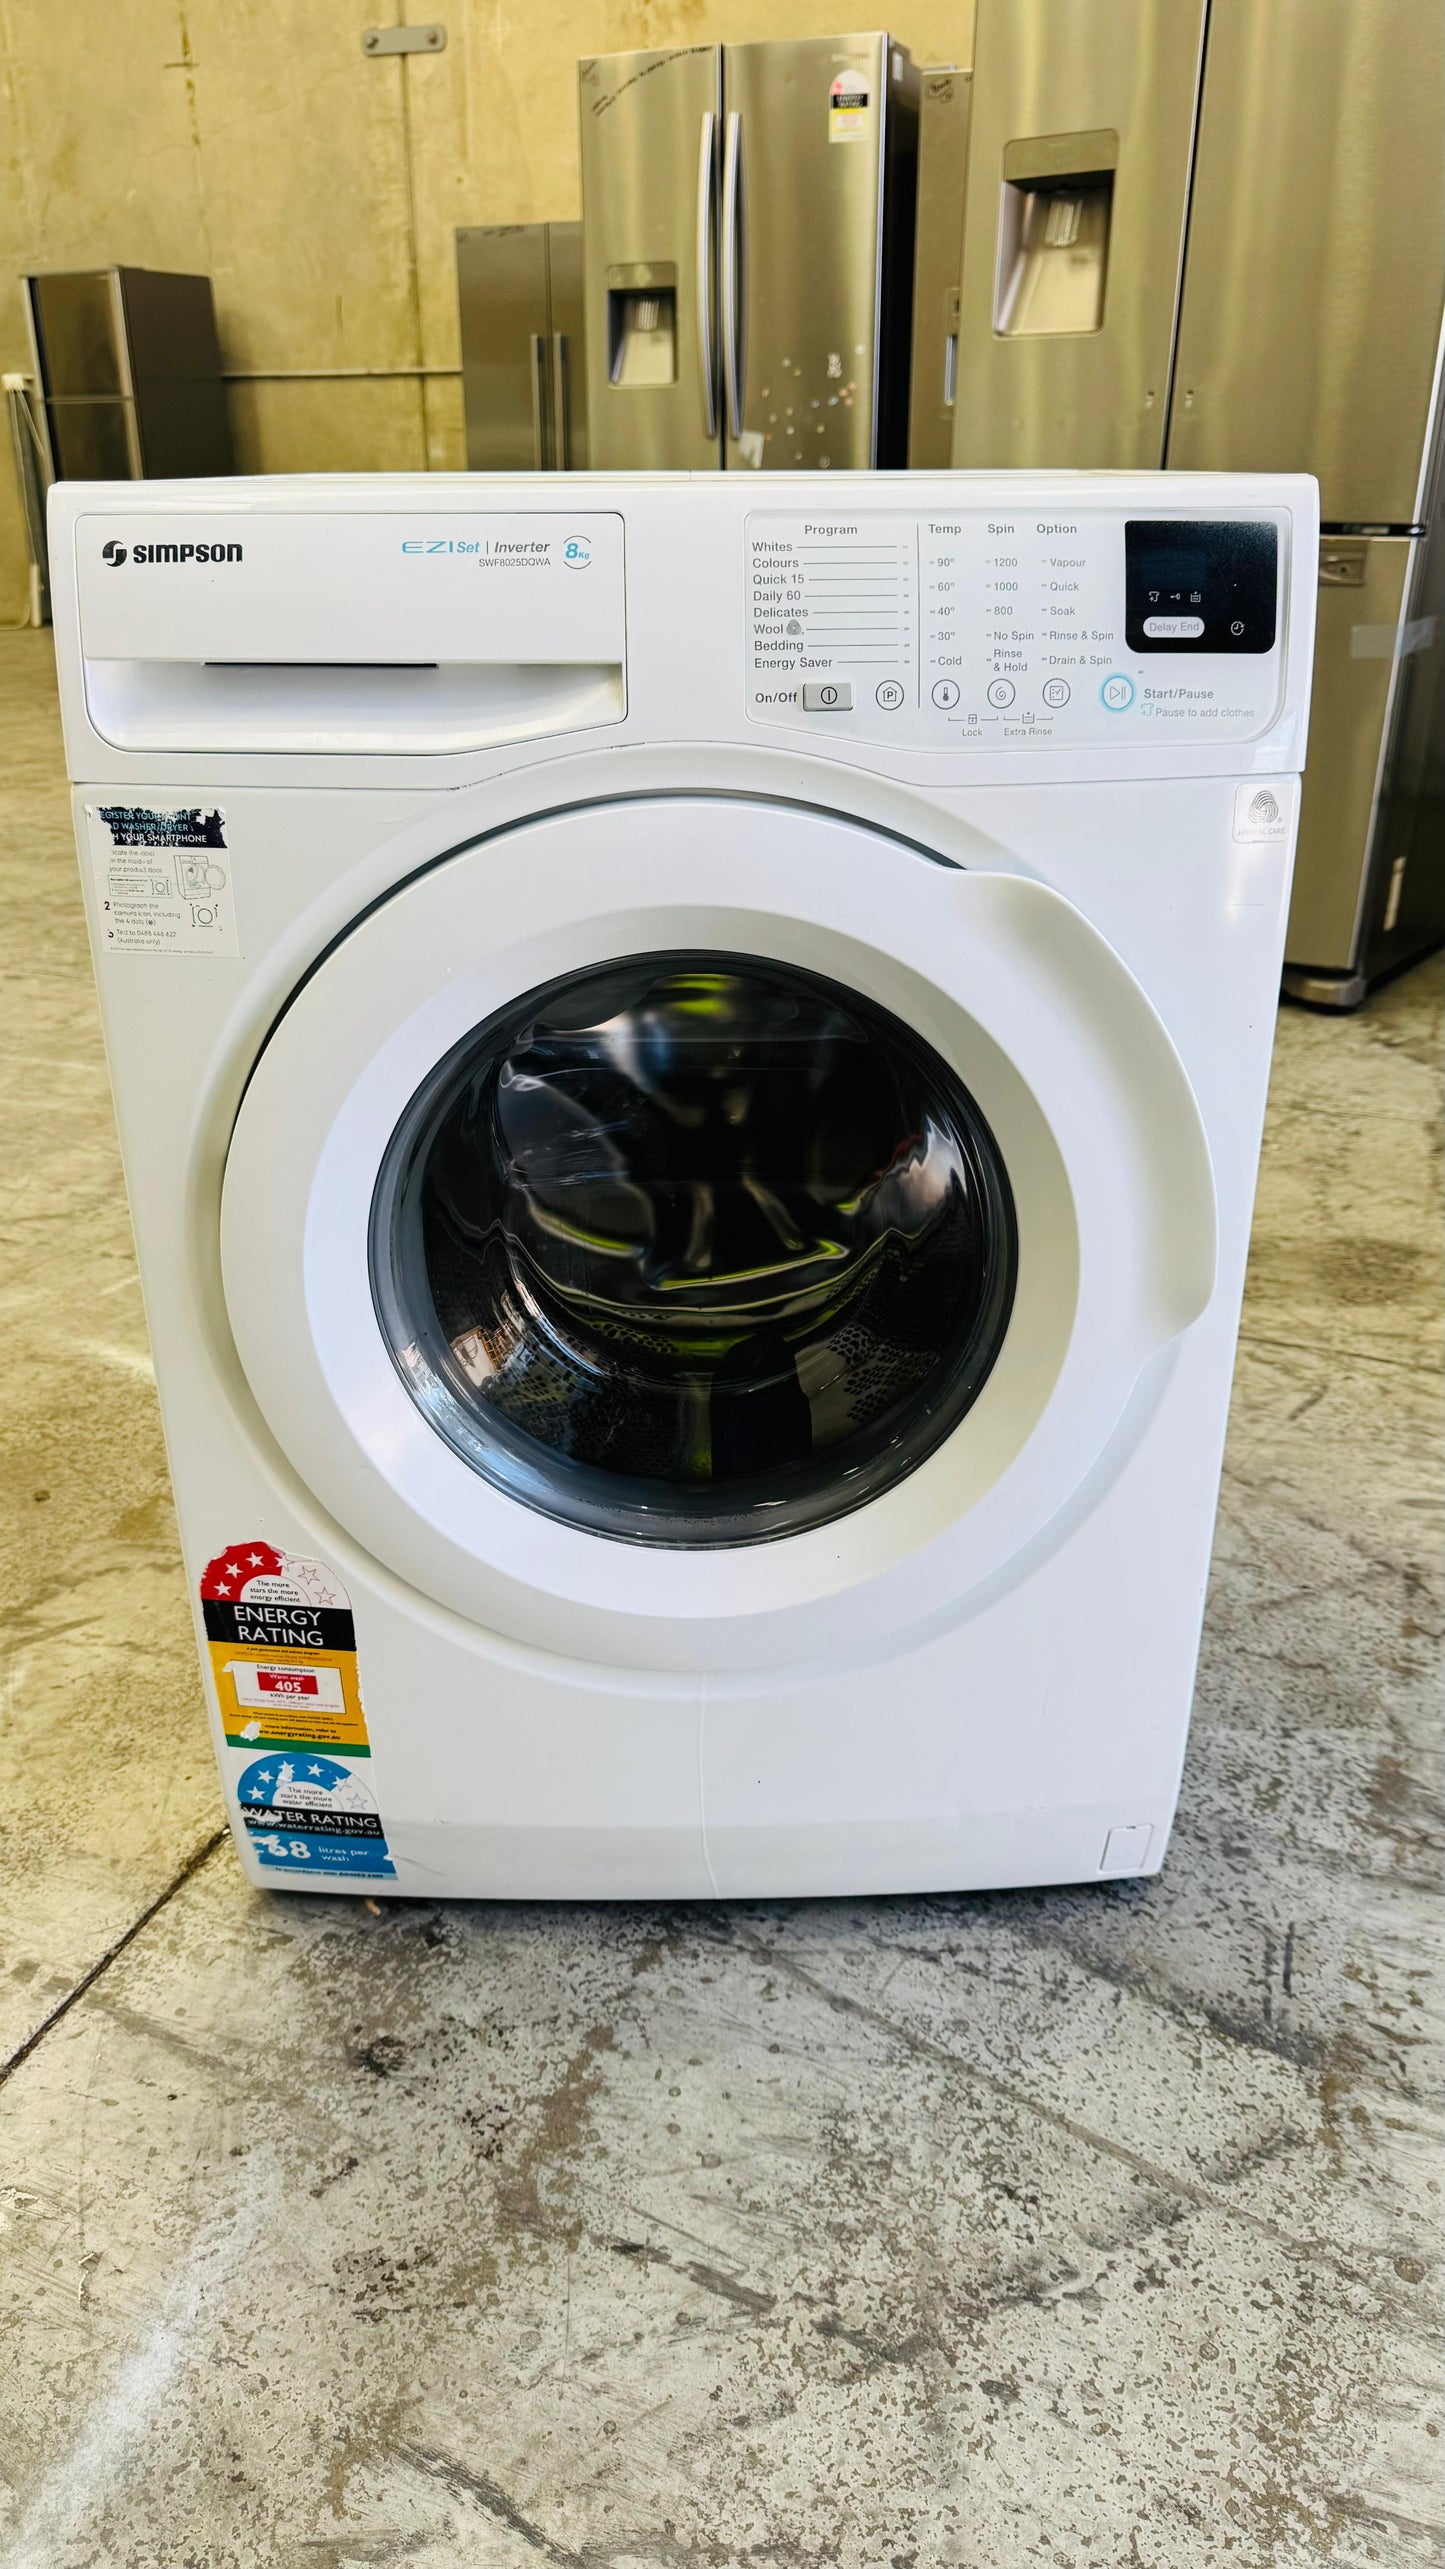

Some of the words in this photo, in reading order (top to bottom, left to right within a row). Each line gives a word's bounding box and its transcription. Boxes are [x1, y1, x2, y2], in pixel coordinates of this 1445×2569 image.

[804, 525, 858, 536] Program
[928, 524, 962, 535] Temp
[988, 524, 1014, 535] Spin
[1036, 524, 1077, 535] Option
[495, 542, 550, 553] Inverter
[752, 542, 793, 552] Whites
[133, 544, 243, 564] SIMPSON
[479, 558, 550, 567] SWF8025DQWA
[752, 558, 799, 568] Colours
[994, 558, 1018, 567] 1200
[1050, 558, 1086, 568] Vapour
[753, 574, 787, 585] Quick
[791, 574, 804, 584] 15
[994, 582, 1018, 591] 1000
[1050, 582, 1079, 592] Quick
[754, 590, 782, 603] Daily
[786, 591, 801, 600] 60
[754, 608, 808, 618] Delicates
[994, 606, 1013, 616] 800
[1050, 606, 1076, 616] Soak
[754, 624, 784, 634] Wool
[1149, 622, 1178, 634] Delay
[1180, 622, 1200, 632] End
[994, 632, 1008, 640] No
[1012, 632, 1034, 642] Spin
[1050, 631, 1078, 640] Rinse
[1081, 631, 1088, 640] &
[1090, 631, 1114, 642] Spin
[754, 640, 804, 652] Bedding
[994, 649, 1022, 658] Rinse
[754, 658, 796, 670] Energy
[800, 658, 833, 668] Saver
[938, 656, 962, 666] Cold
[1050, 656, 1076, 665] Drain
[1080, 656, 1086, 664] &
[1090, 656, 1112, 666] Spin
[994, 663, 1000, 672] &
[1004, 663, 1028, 672] Hold
[755, 692, 798, 704] On/Off
[1144, 688, 1214, 699] Start/Pause
[1156, 708, 1184, 717] Pause
[1188, 708, 1196, 717] to
[1200, 708, 1218, 717] add
[1220, 708, 1254, 717] clothes
[962, 728, 982, 737] Lock
[1004, 728, 1026, 736] Extra
[1028, 728, 1052, 736] Rinse
[100, 812, 134, 820] EGISTER
[147, 834, 207, 842] SMARTPHONE
[104, 901, 110, 910] 2
[234, 1605, 322, 1626] ENERGY
[238, 1626, 324, 1646] RATING
[278, 1665, 316, 1673] consumption
[274, 1680, 302, 1692] 405
[310, 1814, 378, 1828] RATING
[318, 1846, 347, 1855] litres
